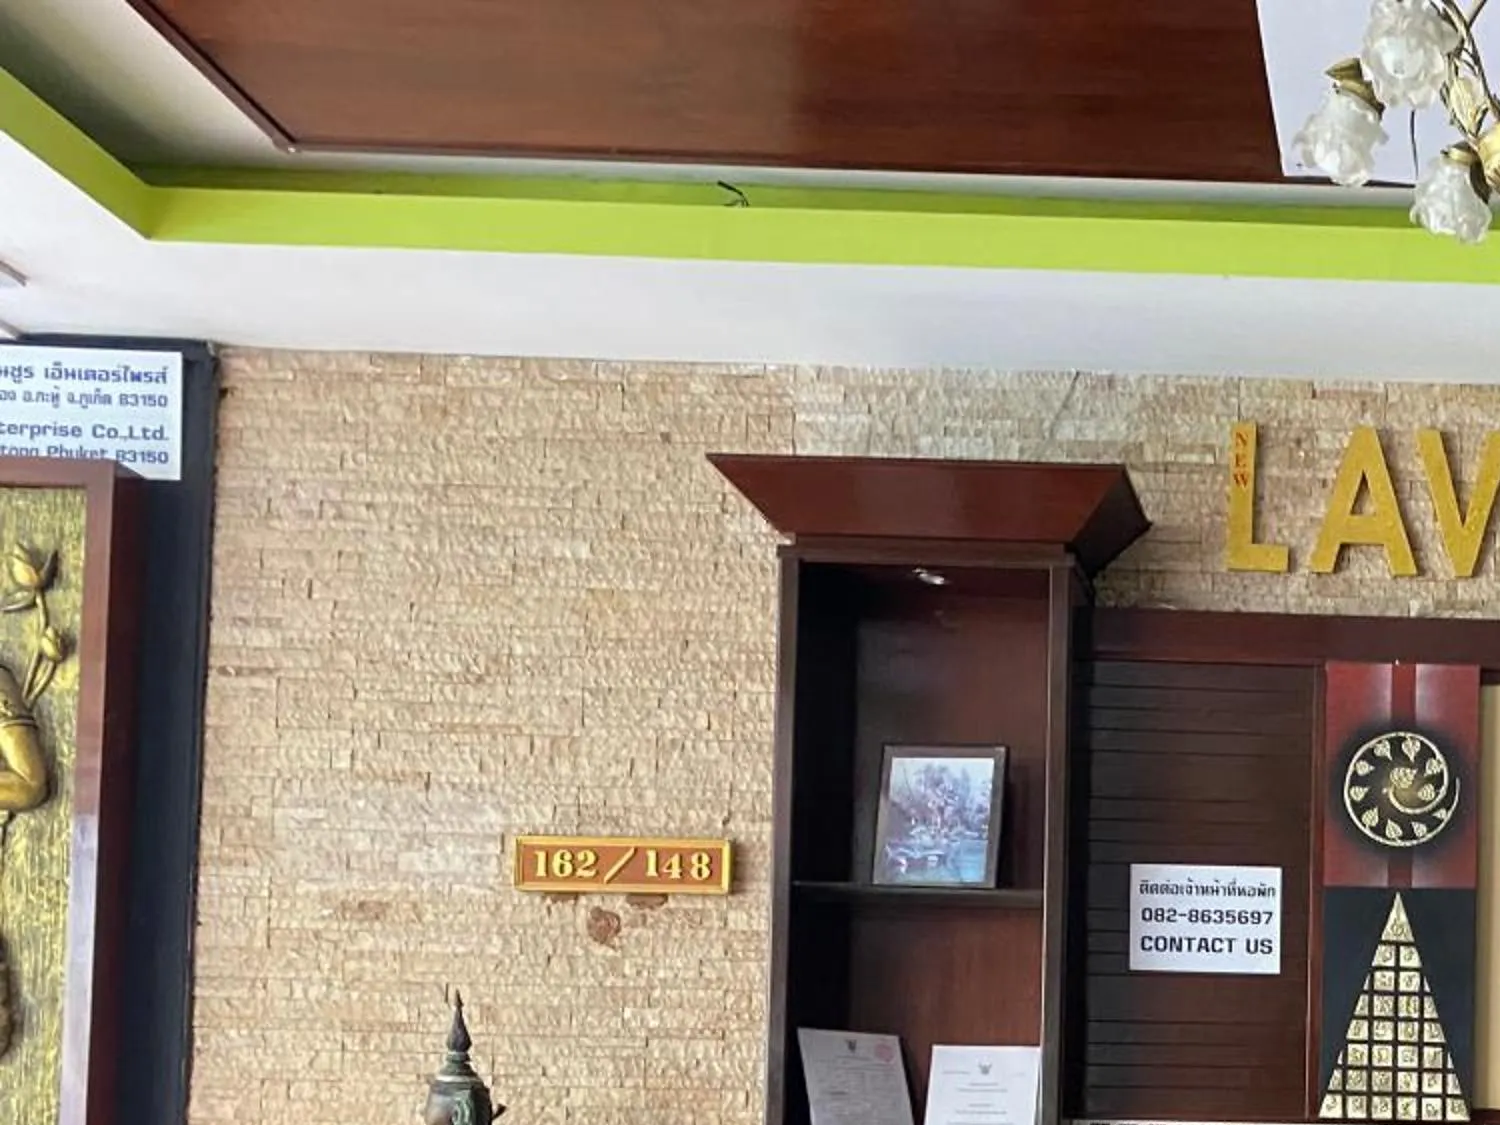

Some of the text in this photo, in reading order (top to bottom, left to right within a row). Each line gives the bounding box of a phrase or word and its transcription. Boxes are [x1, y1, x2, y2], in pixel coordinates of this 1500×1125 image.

[119, 393, 168, 407] 83150
[116, 449, 169, 463] 83150
[1141, 907, 1273, 925] 082-8635697
[1140, 935, 1273, 955] CONTACT US
